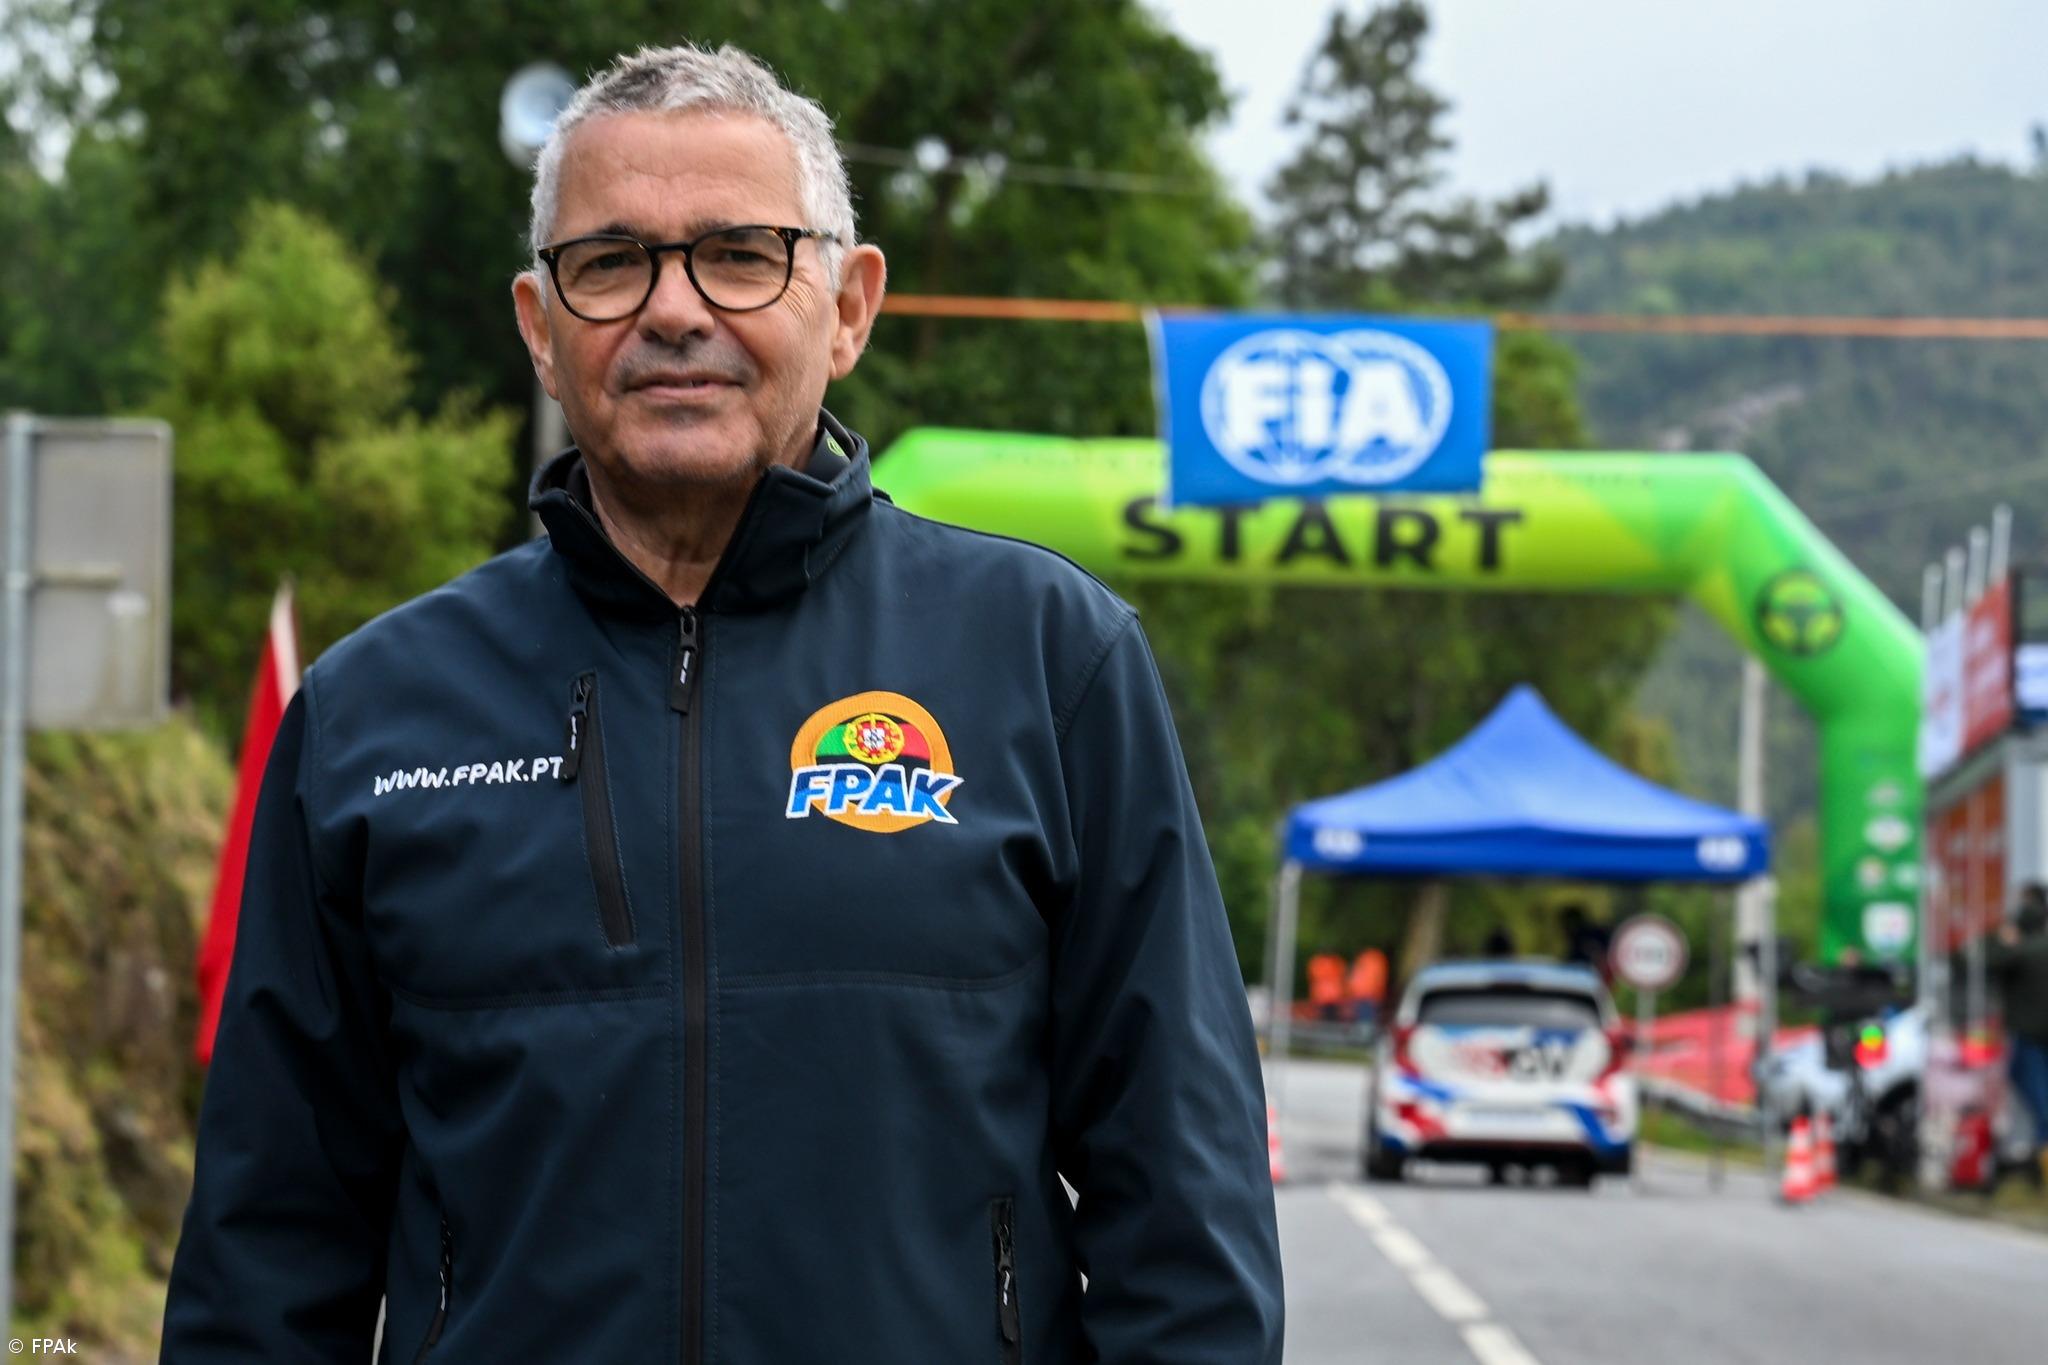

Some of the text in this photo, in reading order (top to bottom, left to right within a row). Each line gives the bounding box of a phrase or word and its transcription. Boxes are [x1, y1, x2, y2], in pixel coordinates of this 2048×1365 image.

[1121, 495, 1523, 571] START
[373, 756, 564, 796] WWW.FPAK.PT
[786, 763, 965, 824] FPAK
